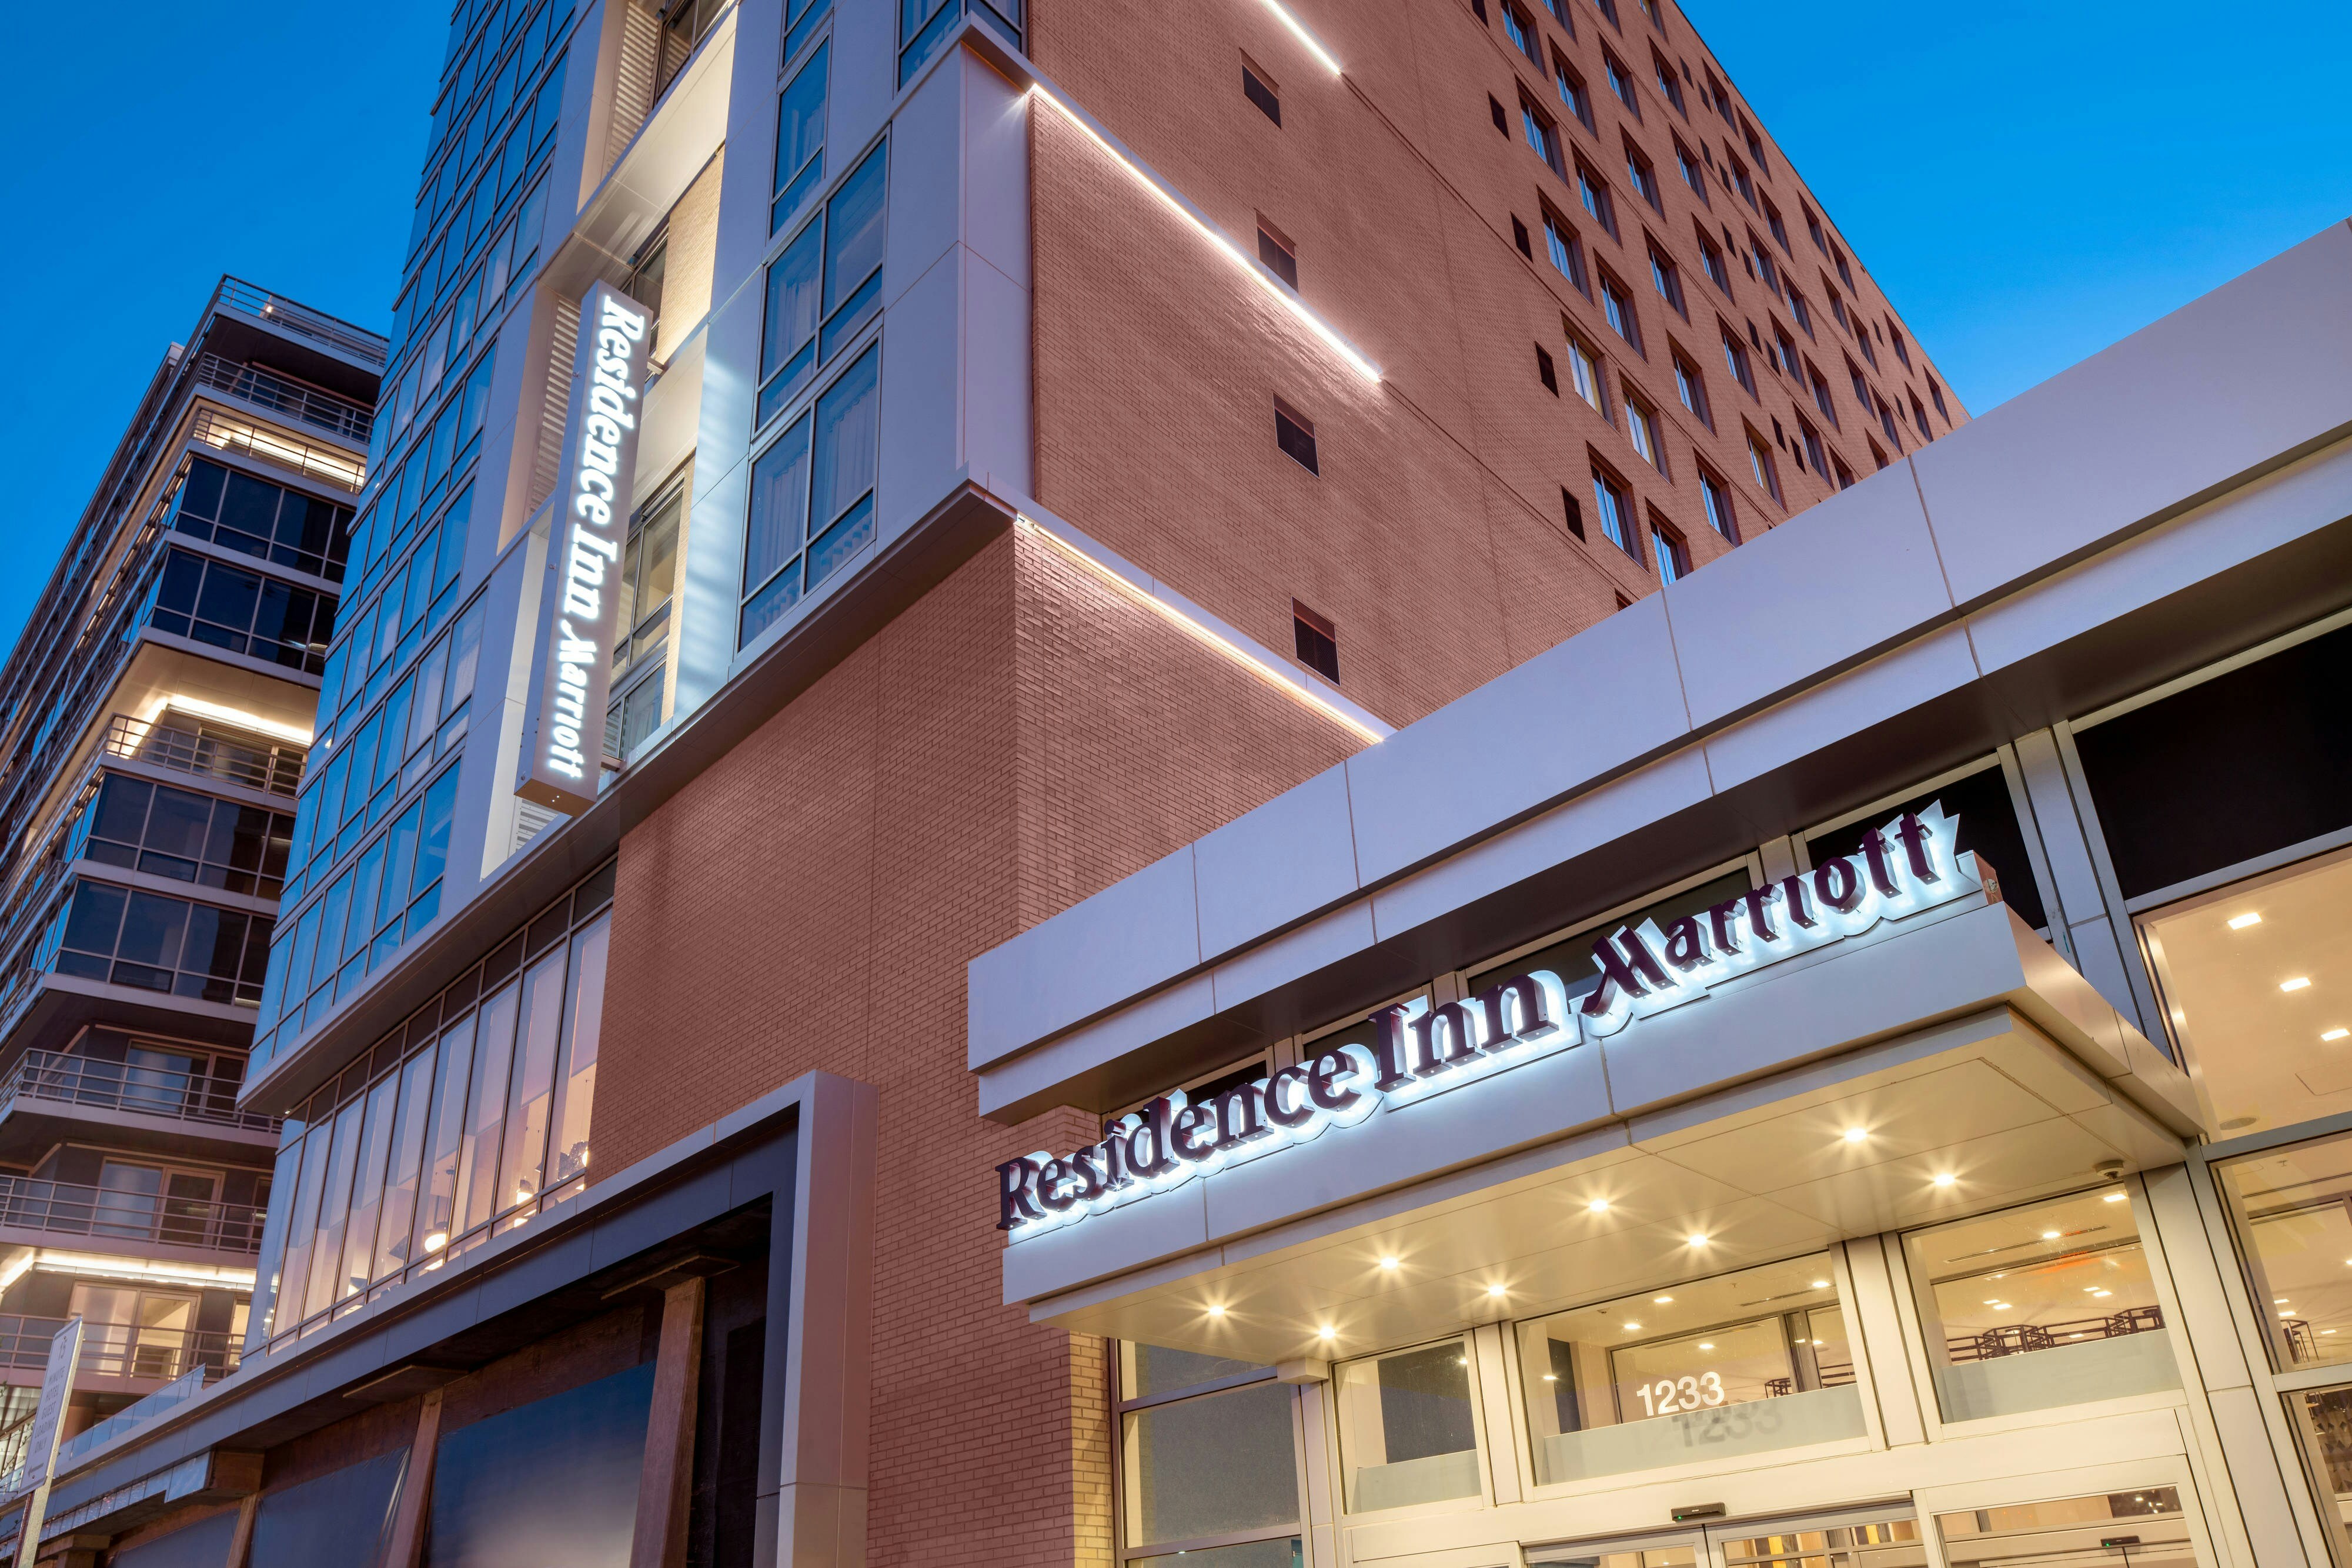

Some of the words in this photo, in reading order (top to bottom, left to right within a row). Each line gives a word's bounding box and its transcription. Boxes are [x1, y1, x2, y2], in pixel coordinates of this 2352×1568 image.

[579, 295, 644, 523] Residence
[563, 523, 618, 622] Inn
[549, 618, 597, 778] Marriott
[995, 1048, 1361, 1231] Residence
[1368, 974, 1559, 1092] Inn
[1581, 812, 1942, 1017] Marriott
[59, 1339, 67, 1360] 15
[48, 1366, 65, 1385] MINUTE
[45, 1385, 59, 1402] HOTEL
[1636, 1372, 1725, 1416] 1233
[41, 1401, 56, 1420] GUEST
[35, 1416, 55, 1439] LOADING
[35, 1437, 48, 1453] ONLY
